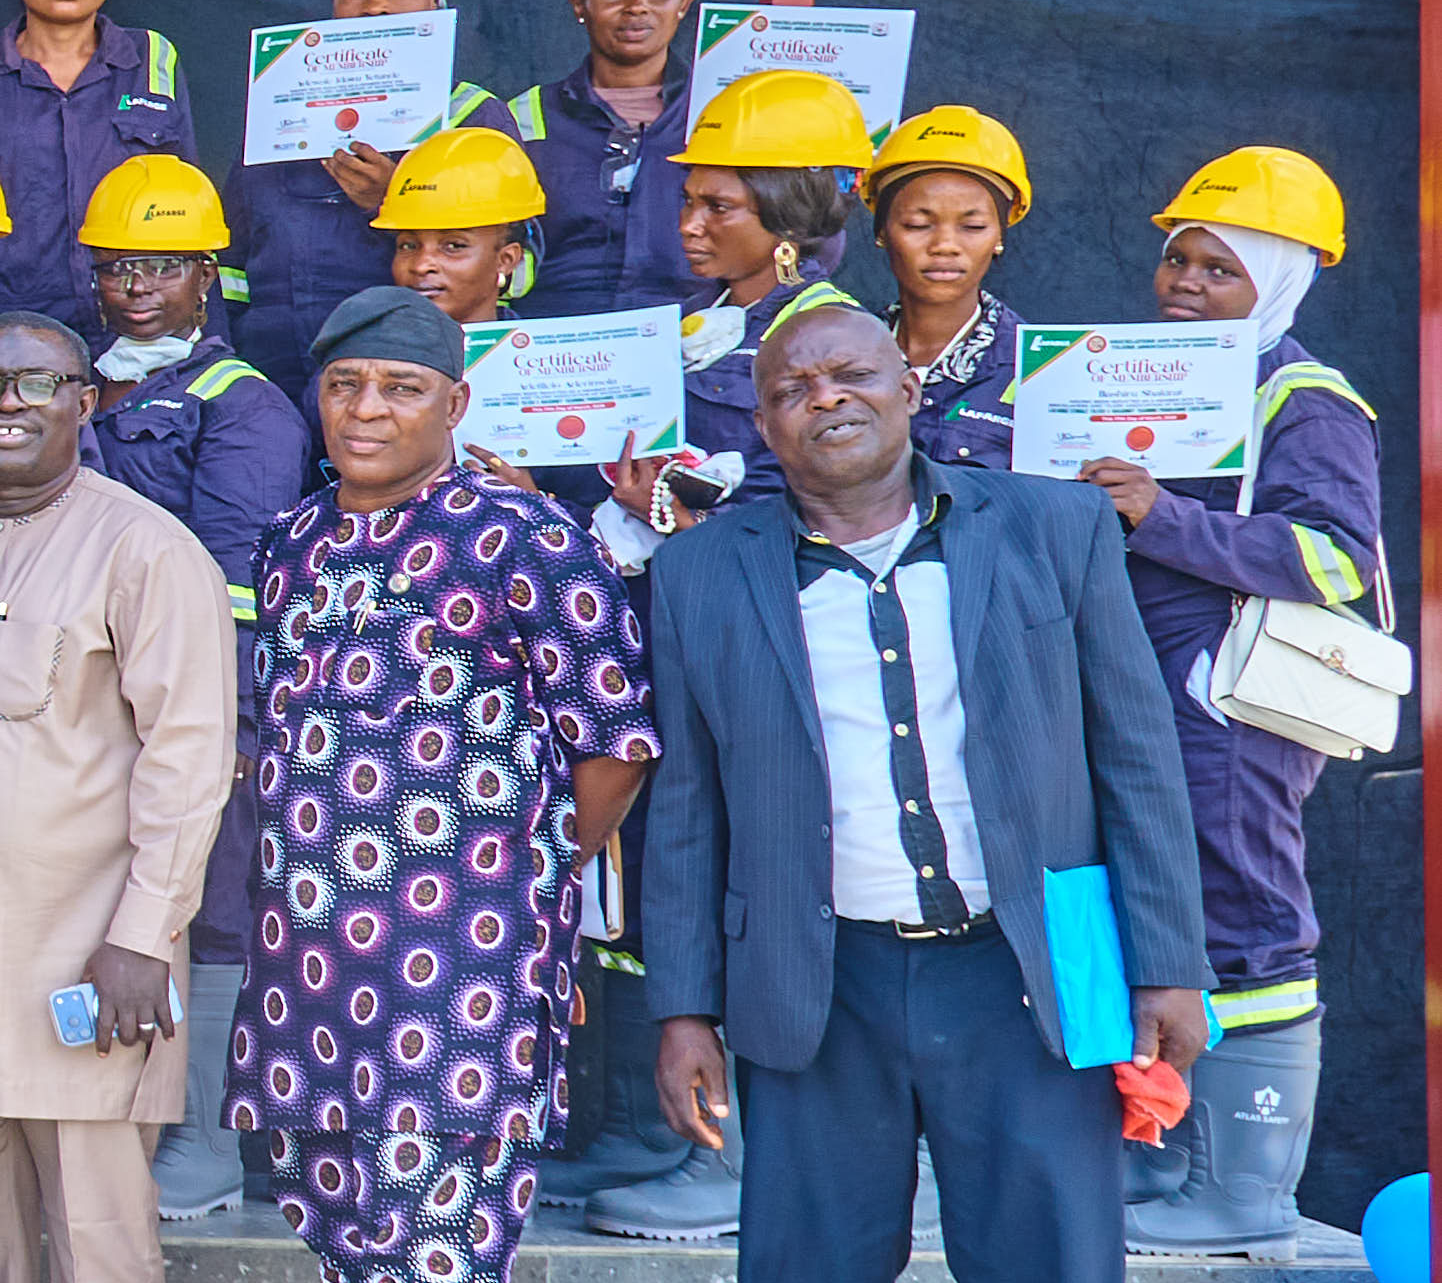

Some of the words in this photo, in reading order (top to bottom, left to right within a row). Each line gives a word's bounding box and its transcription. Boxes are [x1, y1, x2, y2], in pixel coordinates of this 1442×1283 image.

[748, 38, 843, 54] Certificate
[303, 46, 392, 66] Certificate
[514, 350, 616, 369] Certificate
[1086, 358, 1193, 374] Certificate
